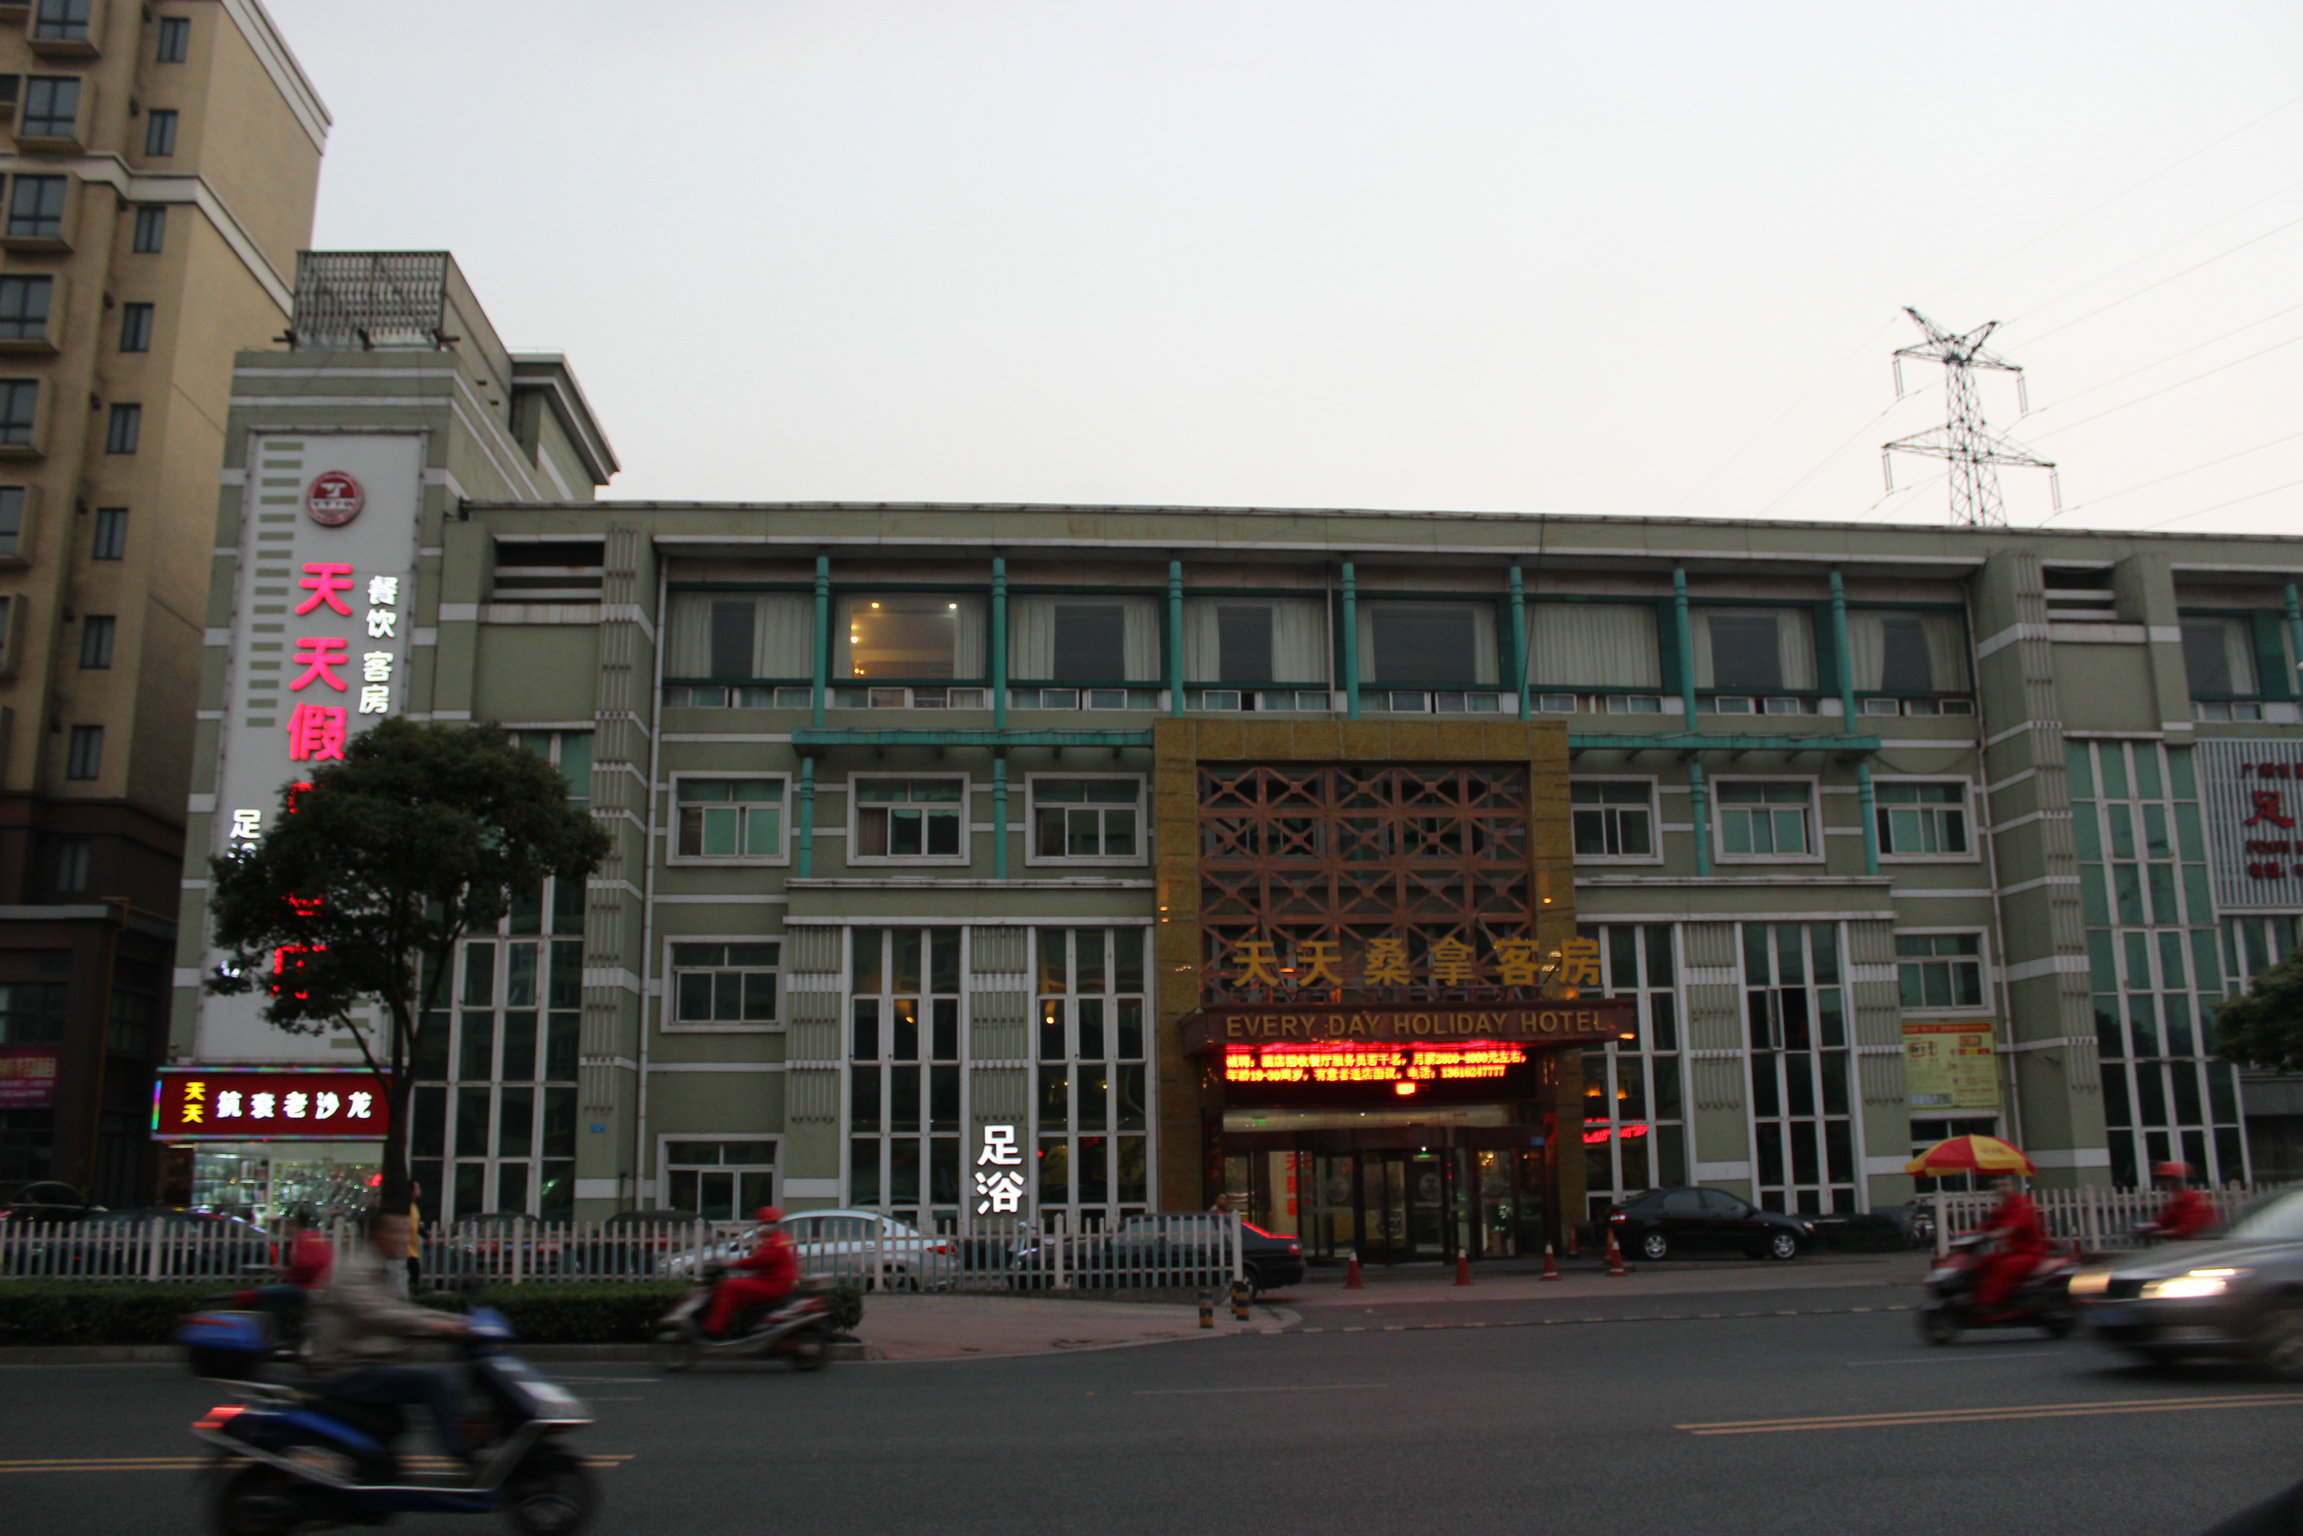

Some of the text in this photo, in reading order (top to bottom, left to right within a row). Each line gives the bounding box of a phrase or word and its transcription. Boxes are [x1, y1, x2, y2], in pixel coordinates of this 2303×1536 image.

[359, 575, 398, 714] 餐饮 客房
[2244, 790, 2295, 829] 足
[1233, 937, 1600, 987] 天天桑拿客房
[1226, 1010, 1608, 1038] EVERY DAY HOLIDAY HOTEL
[182, 1082, 206, 1123] 天天
[216, 1090, 373, 1119] 抗衰老沙龙
[974, 1125, 1025, 1215] 足浴
